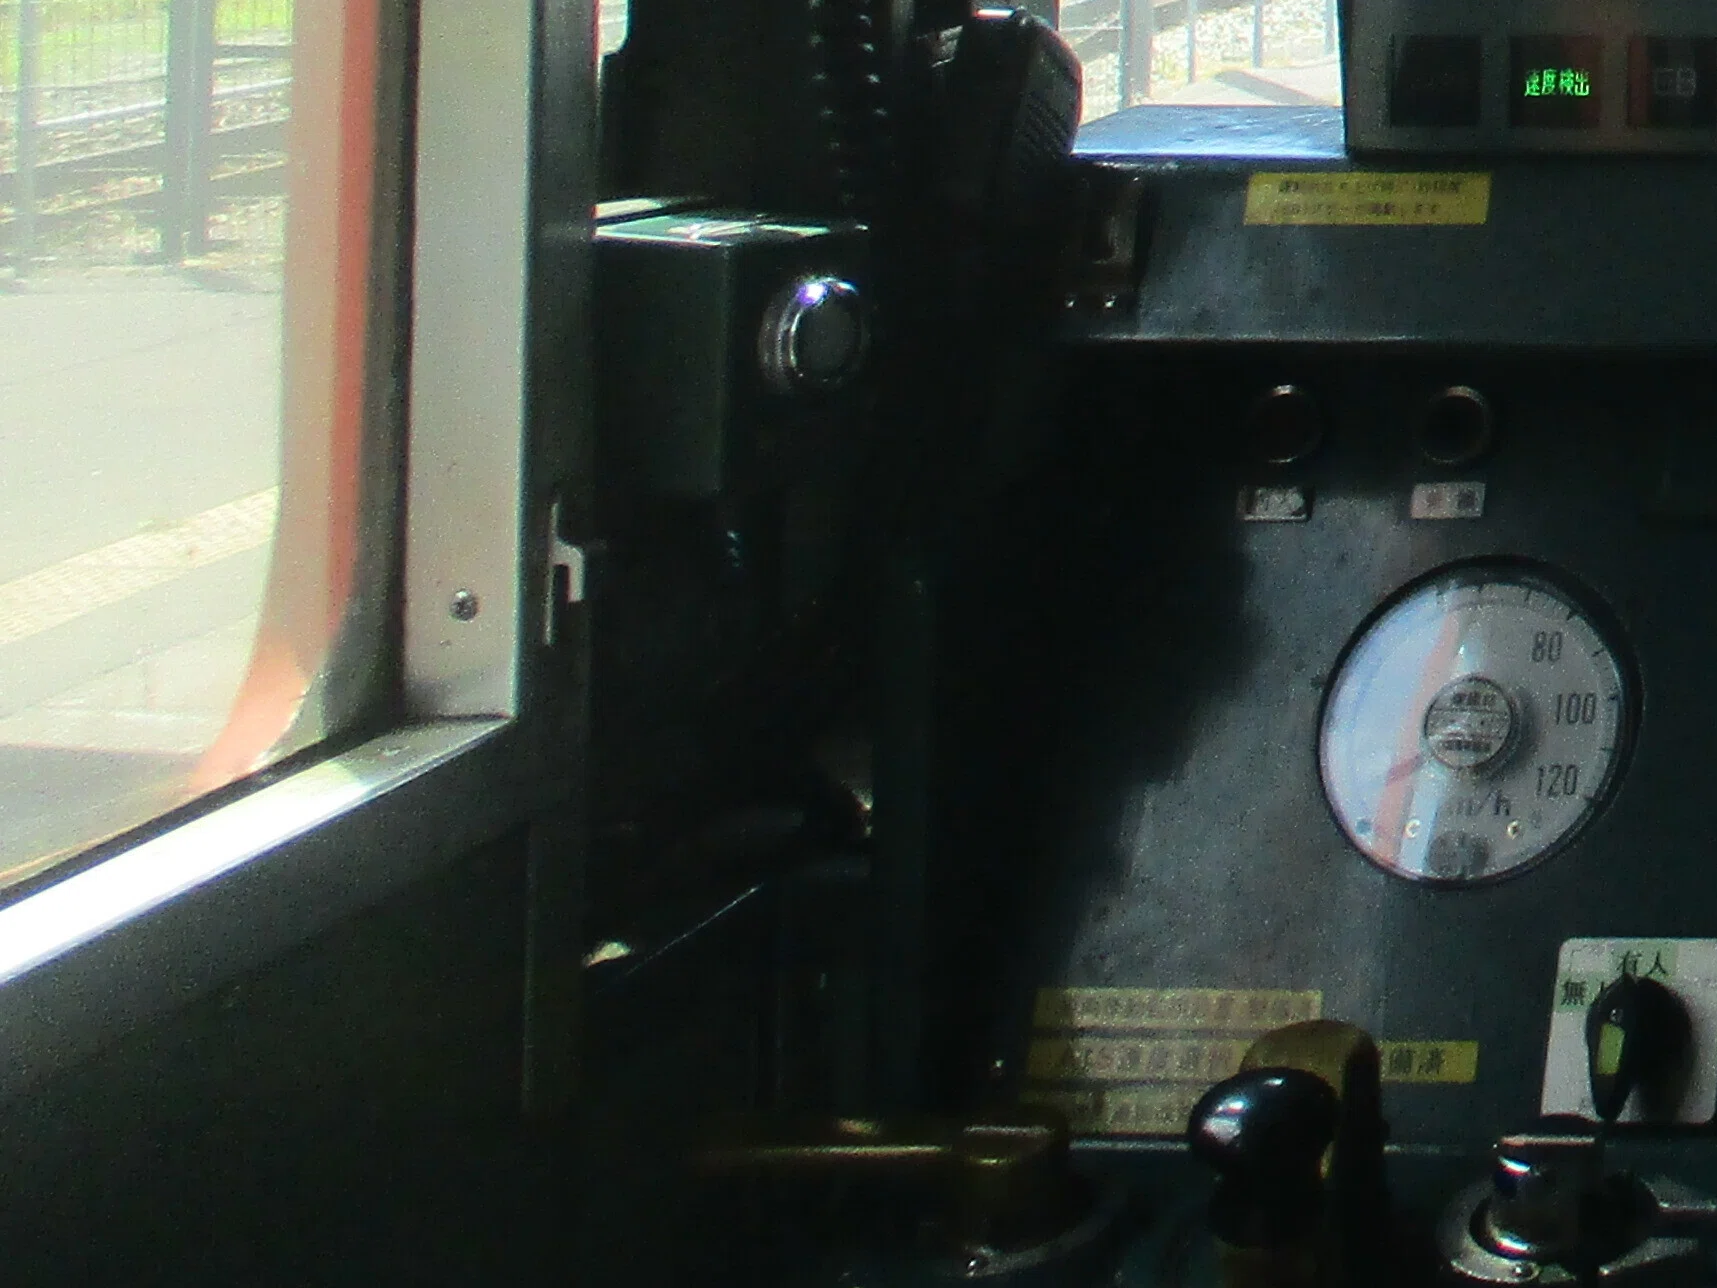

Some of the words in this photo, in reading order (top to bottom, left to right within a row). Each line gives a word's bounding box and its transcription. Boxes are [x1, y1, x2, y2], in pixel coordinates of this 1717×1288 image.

[1523, 67, 1591, 98] 速度検出
[1531, 629, 1564, 663] 80
[1553, 691, 1597, 728] 100
[1534, 763, 1580, 798] 120
[1616, 949, 1668, 976] 有人
